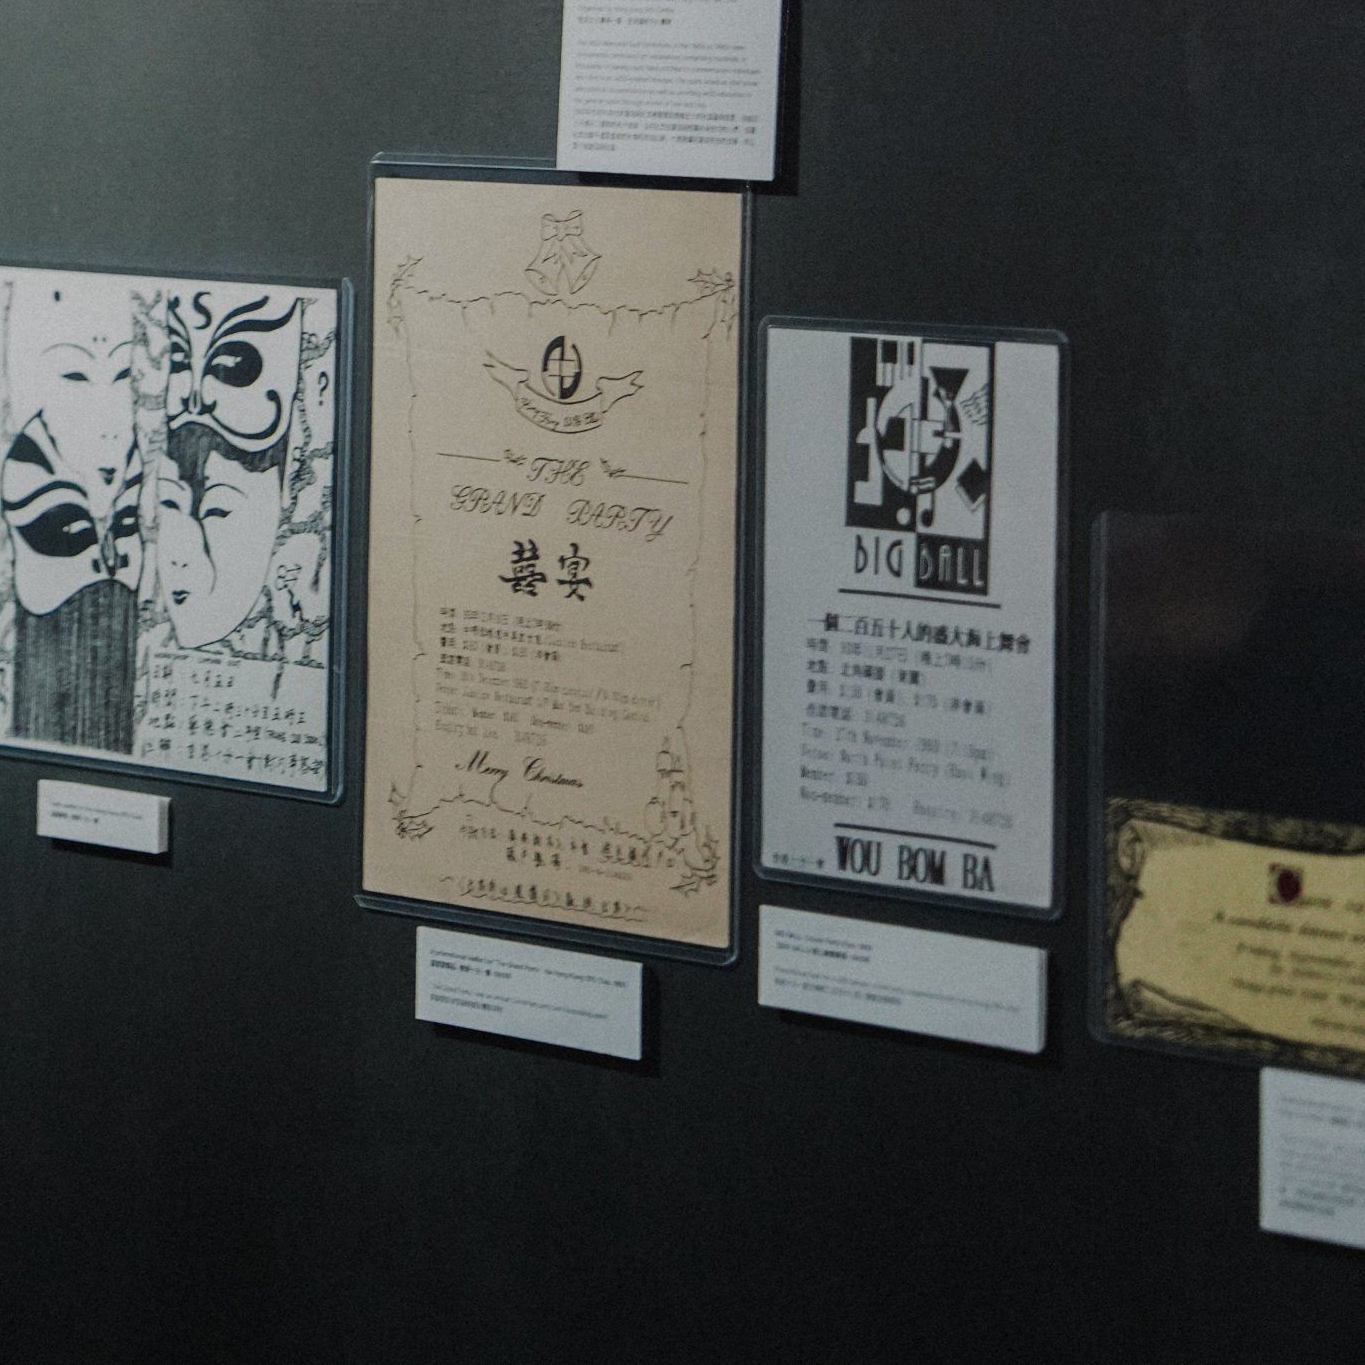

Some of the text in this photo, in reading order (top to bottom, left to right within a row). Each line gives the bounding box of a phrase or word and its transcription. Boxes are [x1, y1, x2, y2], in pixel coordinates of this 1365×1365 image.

[853, 533, 987, 589] BIG BALL
[961, 851, 996, 894] BA
